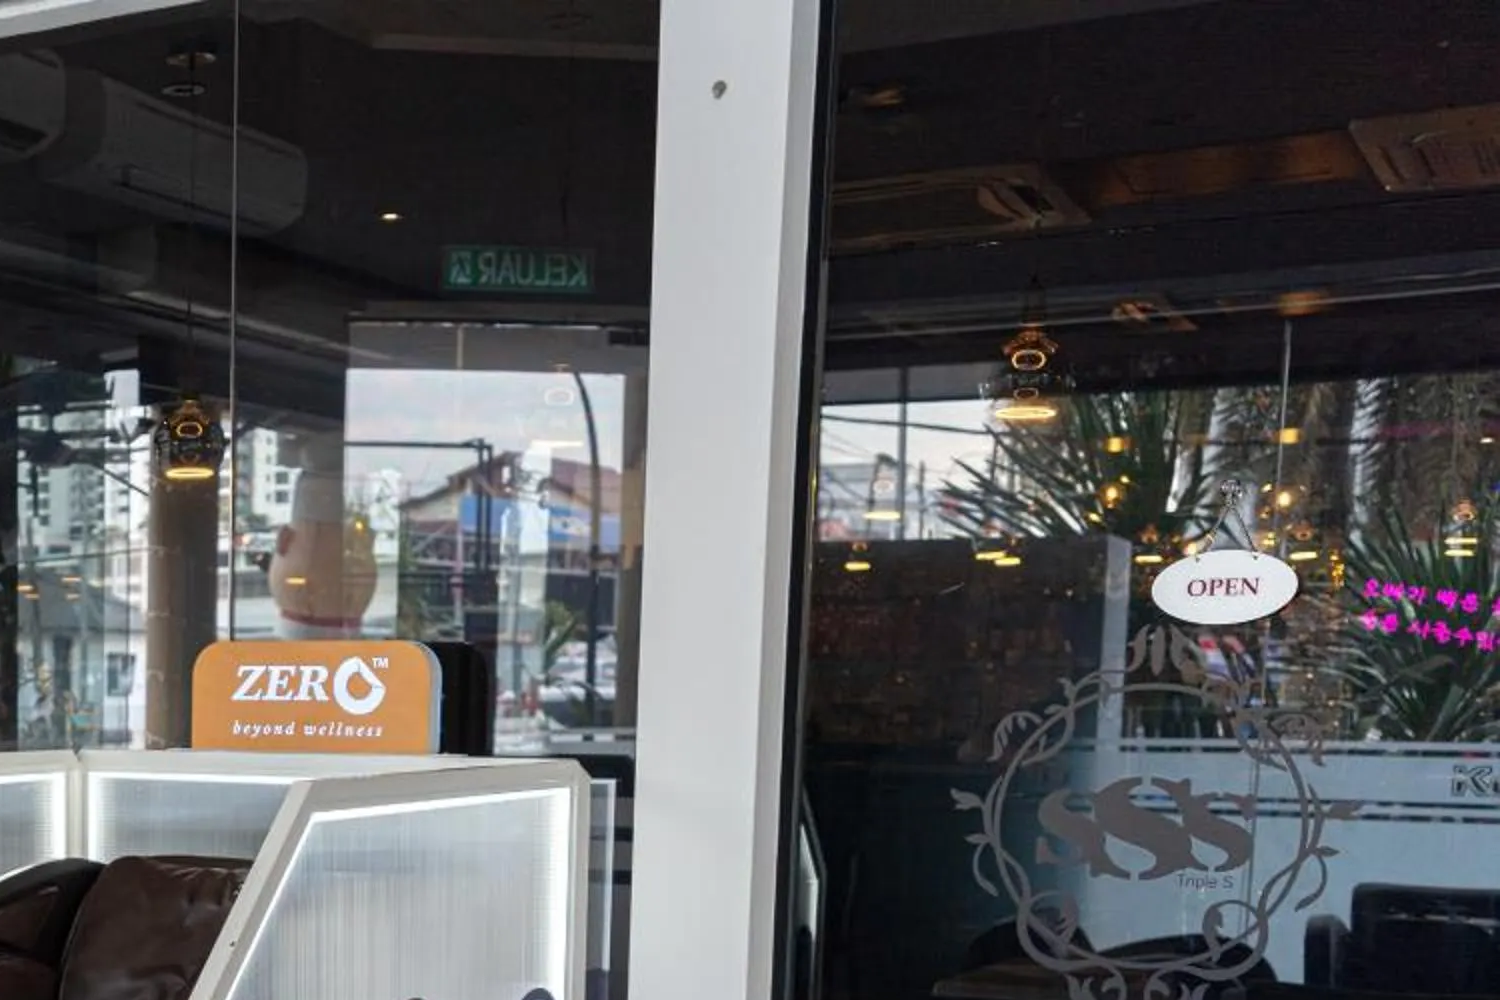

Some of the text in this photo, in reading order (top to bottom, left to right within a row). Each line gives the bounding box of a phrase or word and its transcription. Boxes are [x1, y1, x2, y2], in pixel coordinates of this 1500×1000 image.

[1186, 577, 1261, 597] OPEN
[230, 655, 387, 716] ZERO
[231, 719, 384, 738] beyond wellness
[1177, 873, 1235, 892] Triple S
